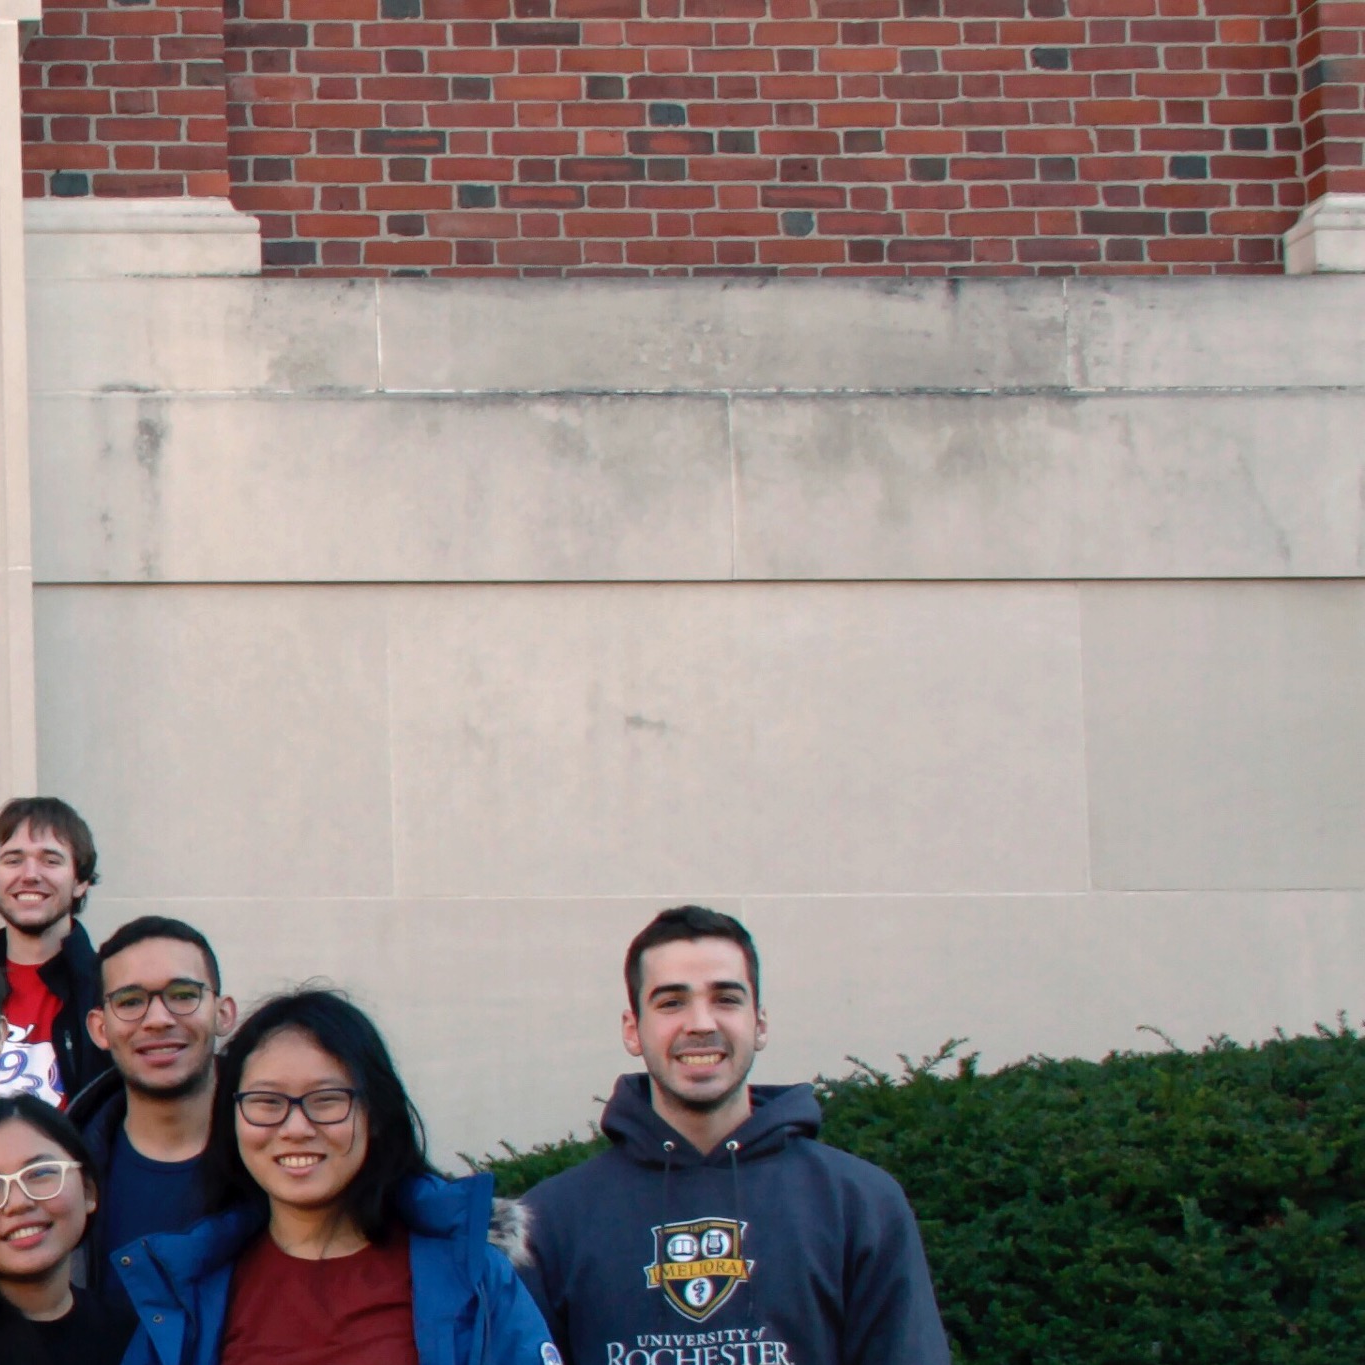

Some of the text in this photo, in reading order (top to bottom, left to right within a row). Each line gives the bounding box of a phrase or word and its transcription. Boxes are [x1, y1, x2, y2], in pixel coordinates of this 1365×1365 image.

[663, 1259, 738, 1278] MELIORA
[636, 1326, 767, 1347] UNIVERSITY of
